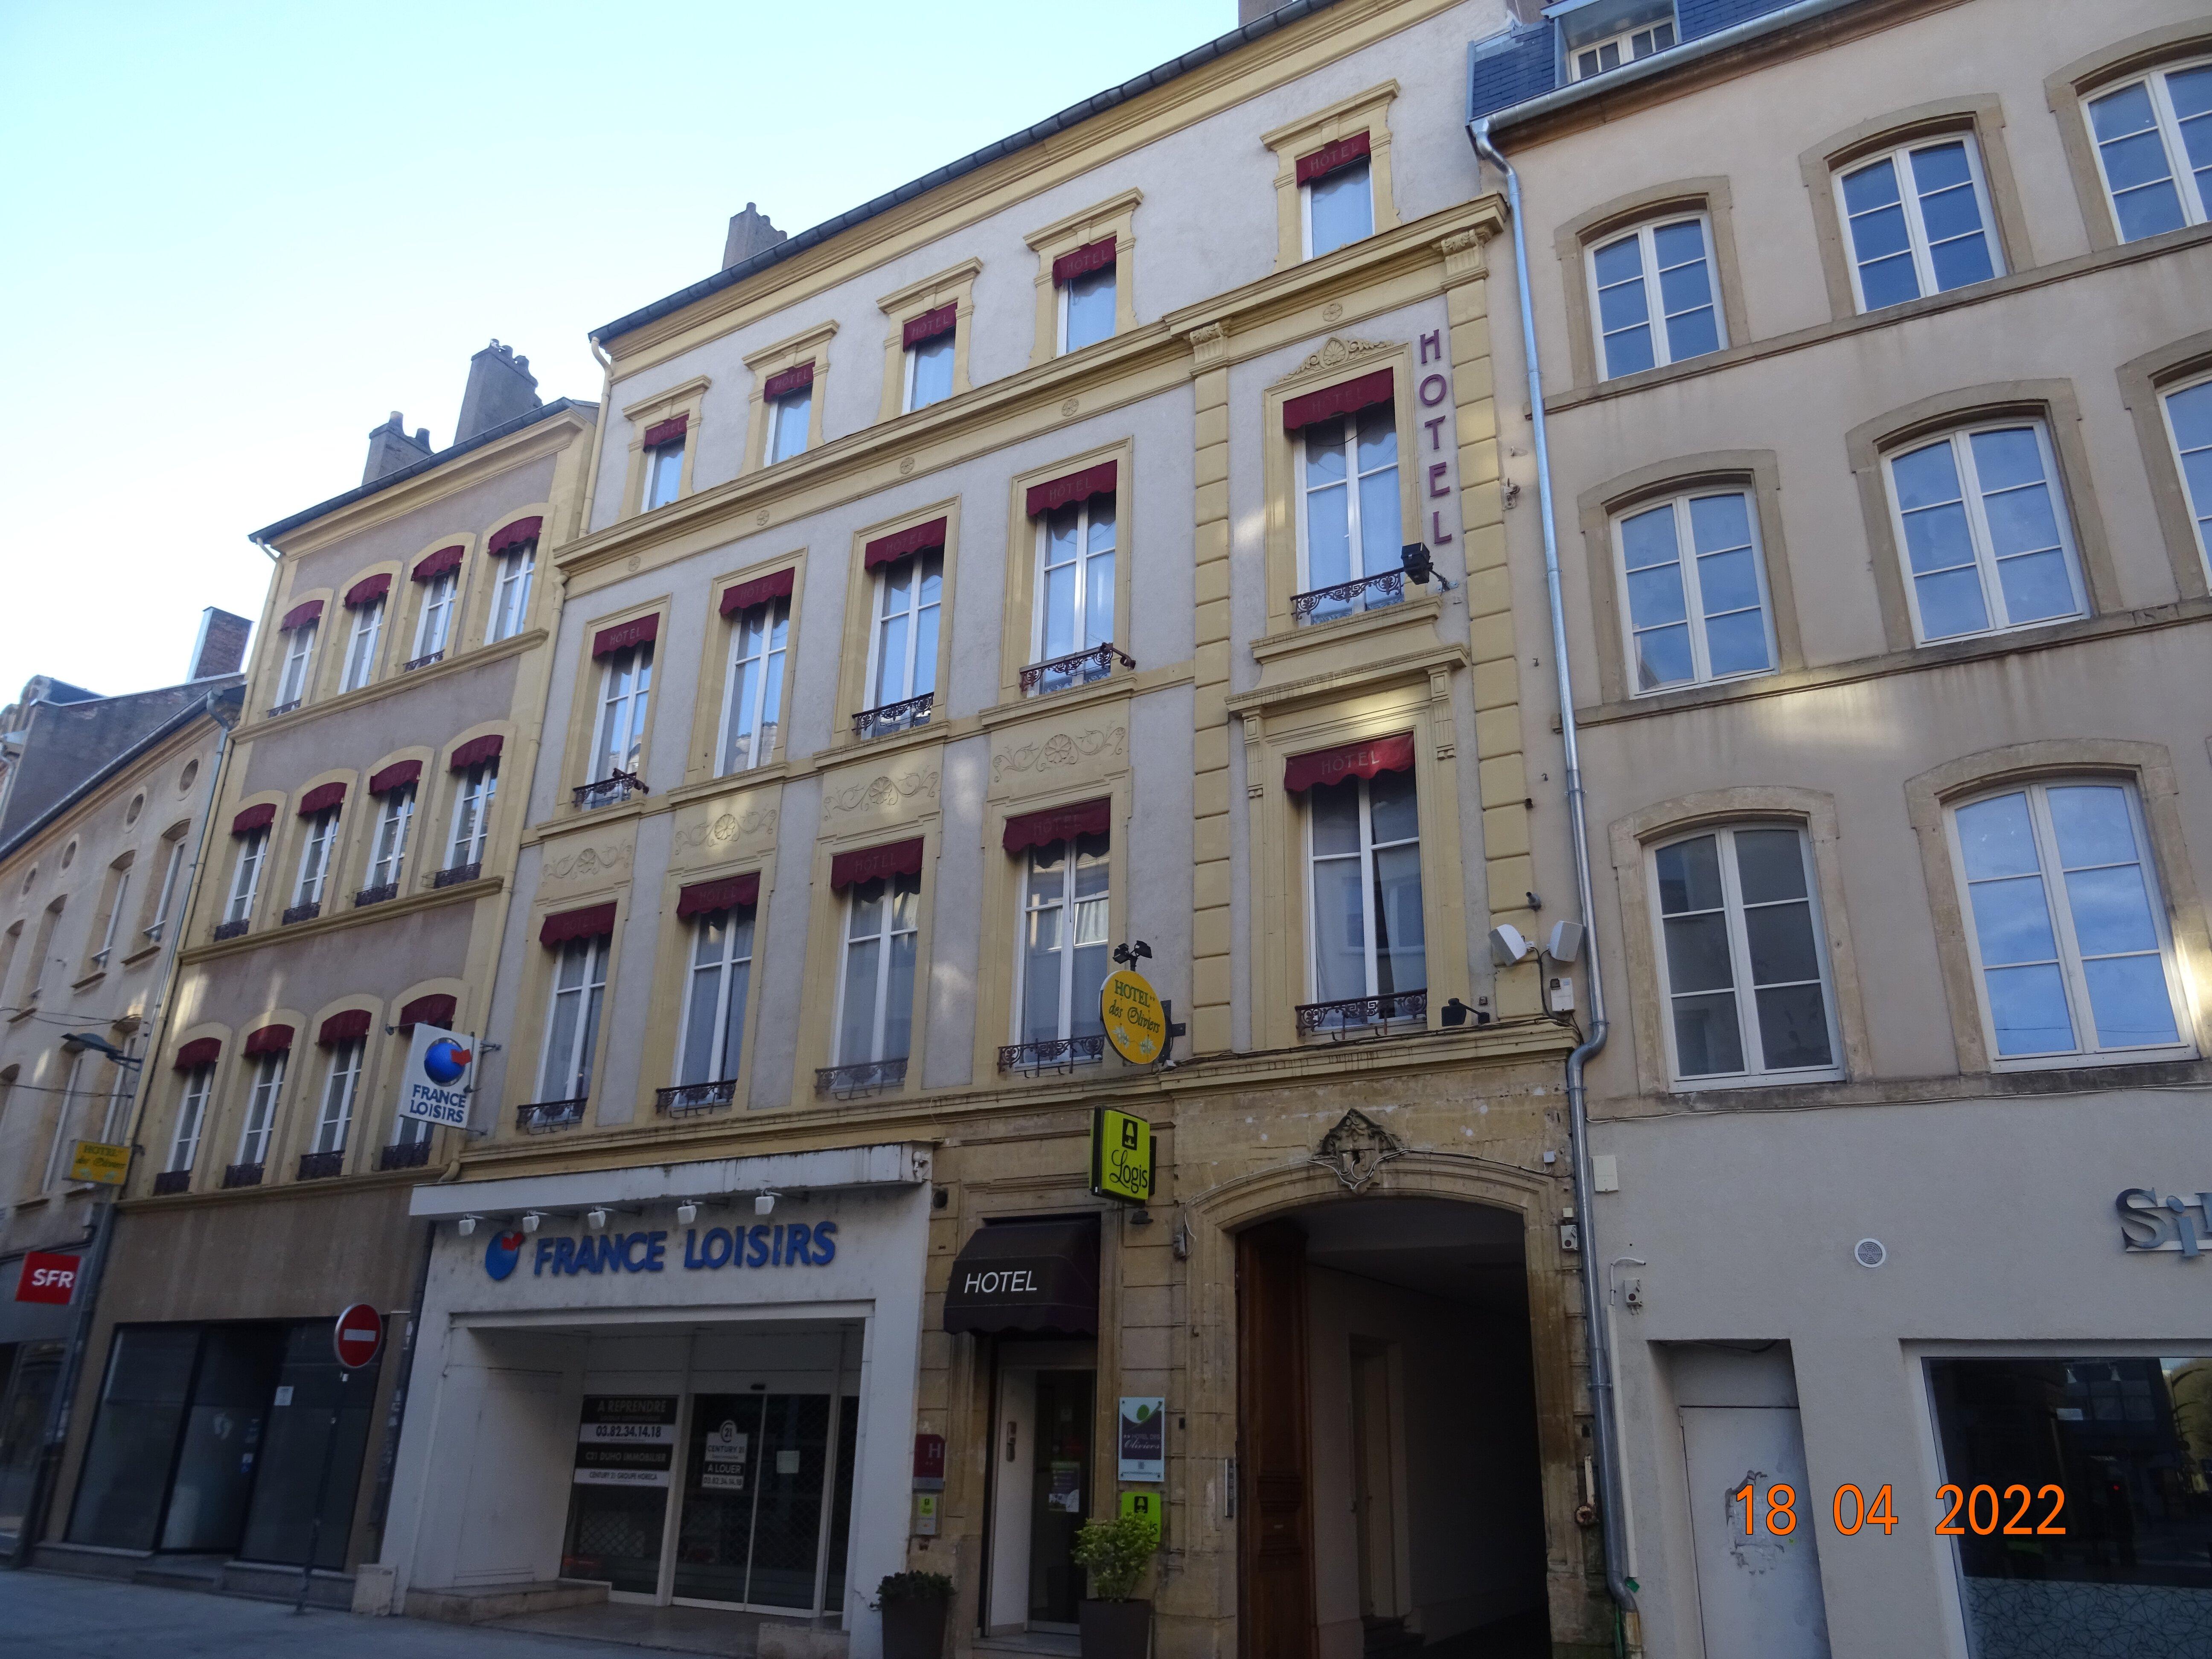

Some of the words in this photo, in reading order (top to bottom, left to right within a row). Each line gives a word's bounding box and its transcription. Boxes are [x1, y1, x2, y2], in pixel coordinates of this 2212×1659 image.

[1419, 329, 1452, 544] HOTEL
[1115, 979, 1150, 1008] HOTEL
[1109, 999, 1123, 1018] des
[1127, 1007, 1160, 1033] Oliviers
[413, 1084, 466, 1108] FRANCE
[410, 1100, 464, 1123] LOISIRS
[1109, 1150, 1148, 1193] Logis
[534, 1231, 668, 1275] FRANCE
[684, 1221, 837, 1270] LOISIRS
[32, 1269, 74, 1288] SFR
[964, 1270, 1037, 1293] HOTEL
[597, 1401, 605, 1412] A
[608, 1400, 667, 1413] REPRENDRE
[596, 1426, 661, 1438] 03.82.34.14.18
[929, 1443, 941, 1458] H
[707, 1464, 713, 1473] A
[715, 1464, 742, 1474] LOUER
